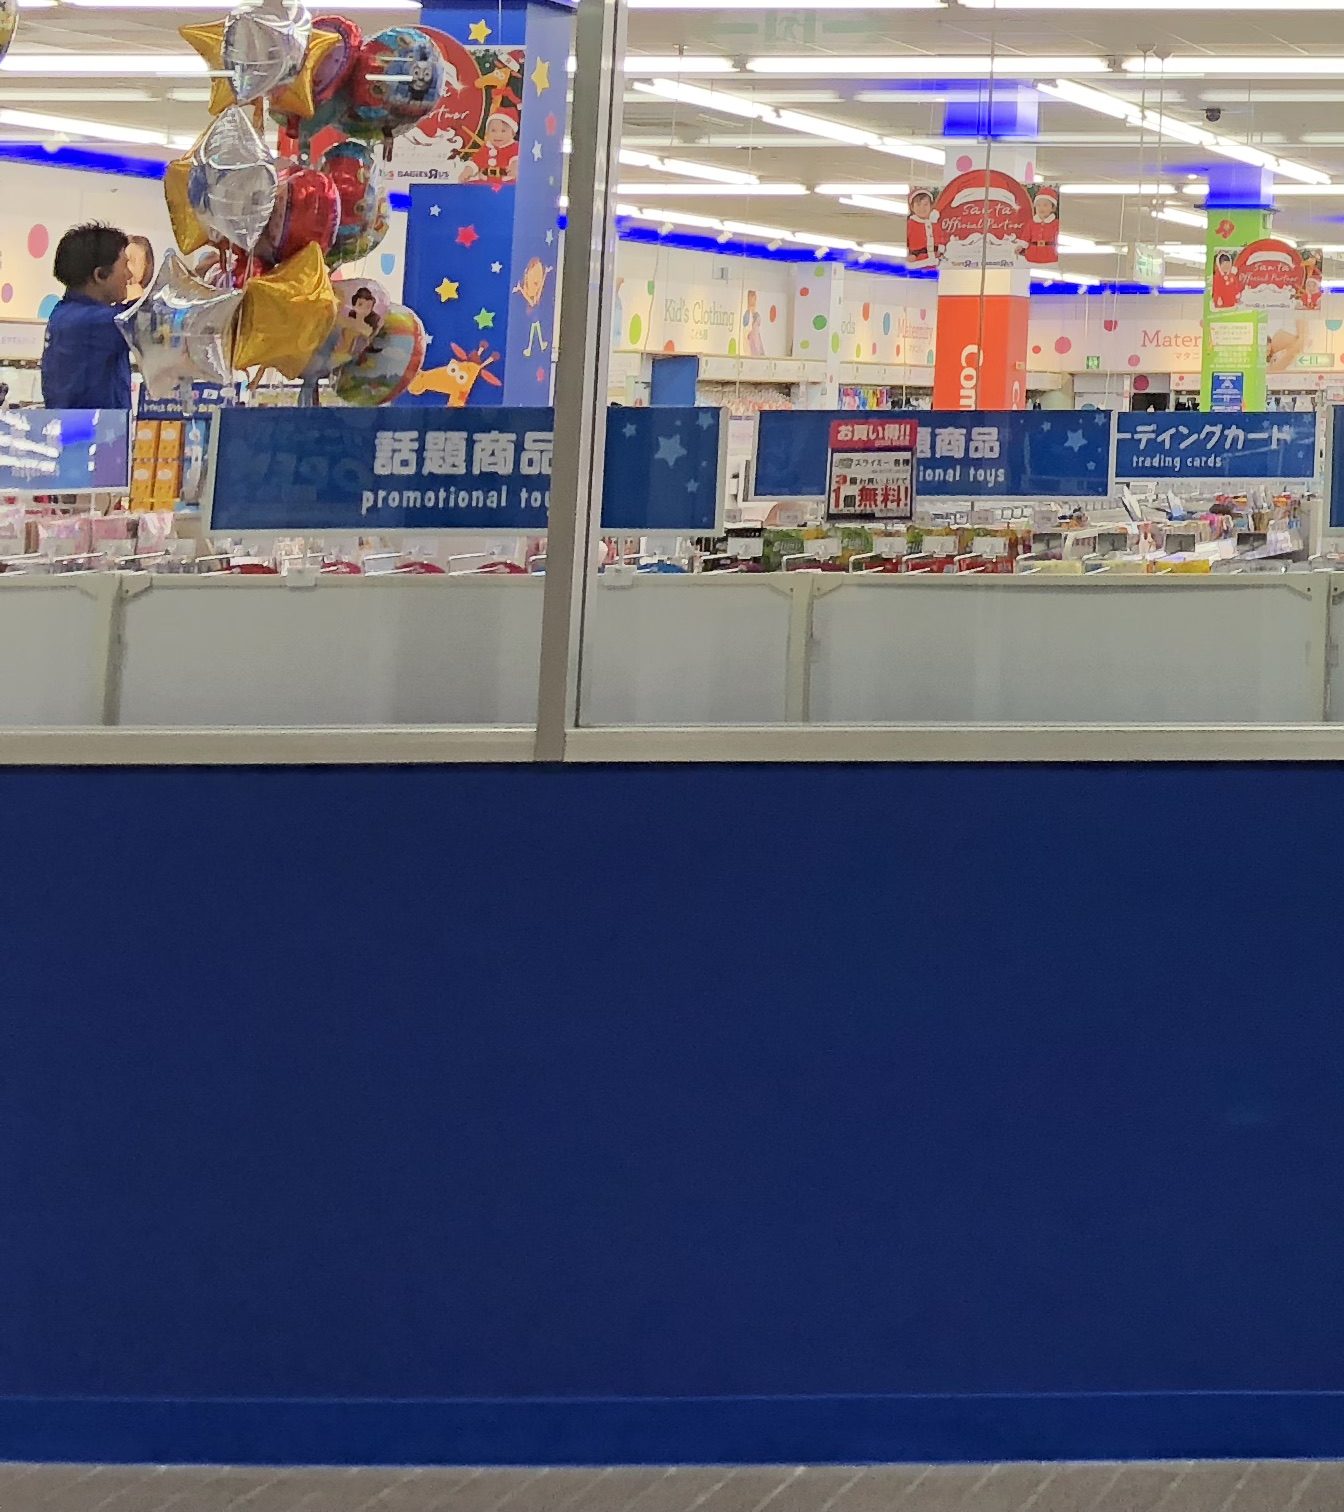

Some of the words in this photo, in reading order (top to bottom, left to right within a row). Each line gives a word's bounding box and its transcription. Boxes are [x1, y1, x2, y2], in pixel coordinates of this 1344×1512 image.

[1140, 330, 1201, 348] Mater
[373, 430, 553, 476] 話題商品
[1132, 453, 1181, 471] trading
[1186, 453, 1223, 468] cards
[969, 465, 1006, 488] toys
[361, 485, 507, 516] promotional
